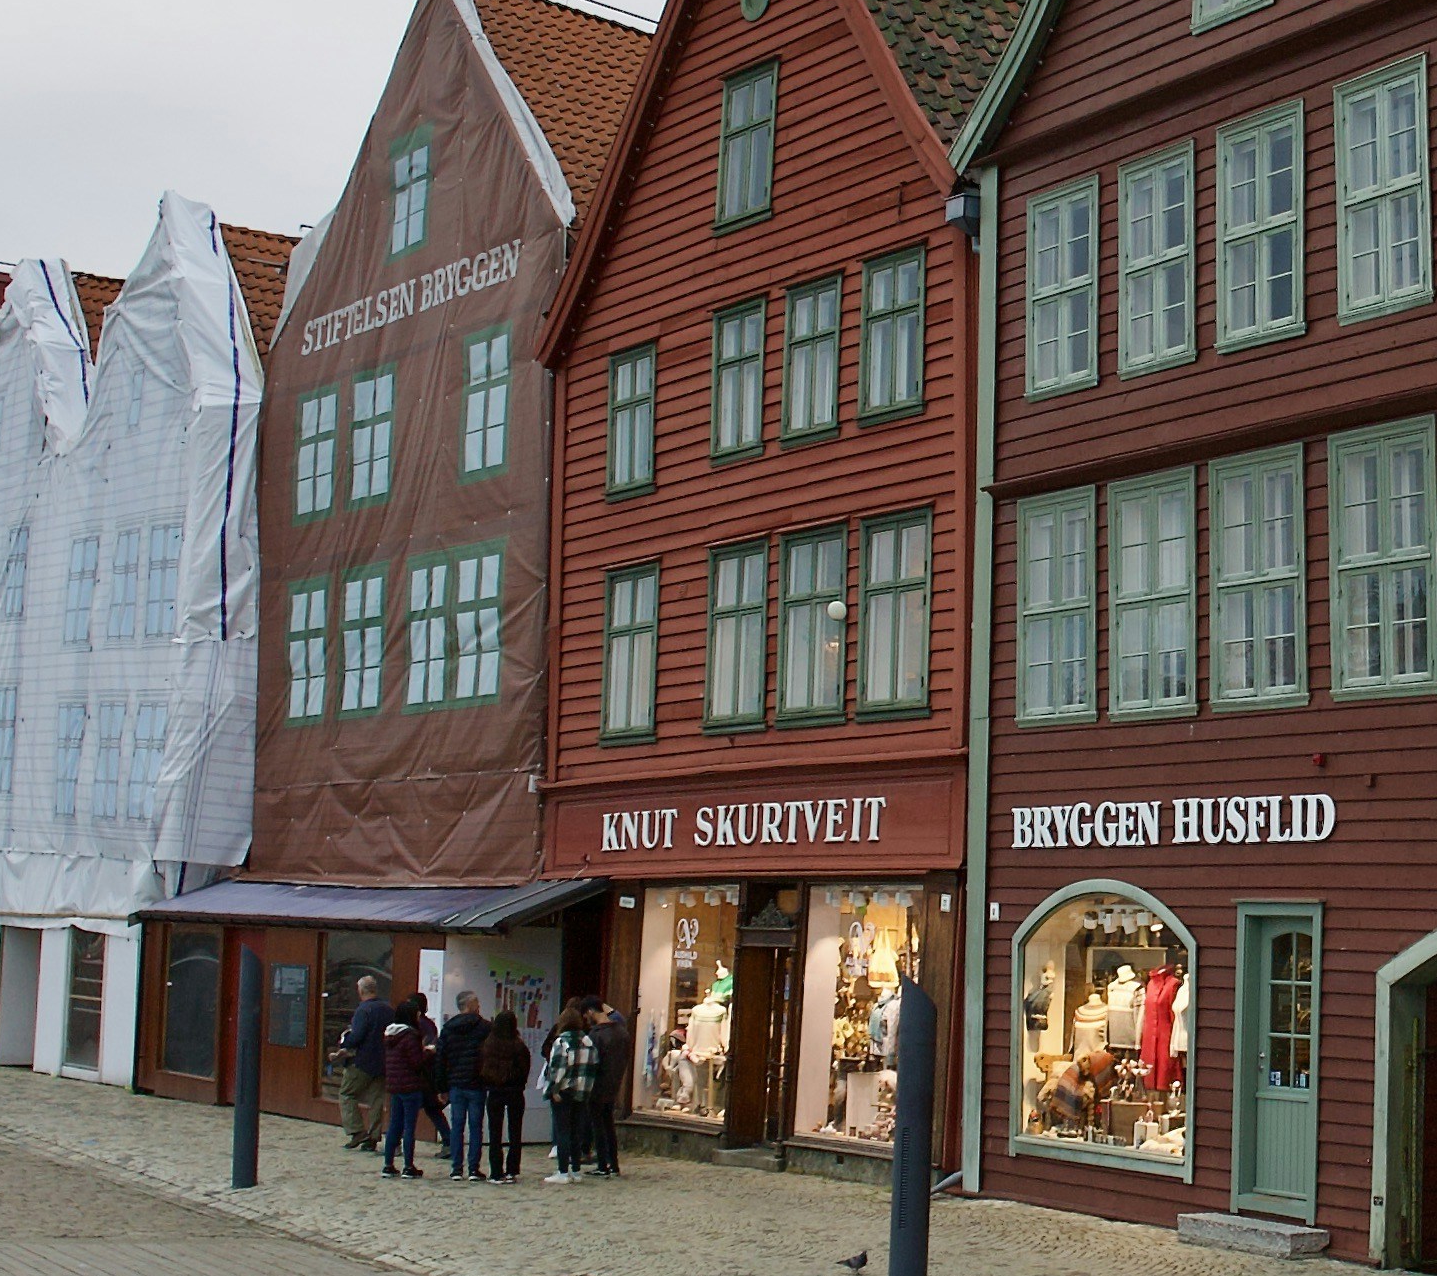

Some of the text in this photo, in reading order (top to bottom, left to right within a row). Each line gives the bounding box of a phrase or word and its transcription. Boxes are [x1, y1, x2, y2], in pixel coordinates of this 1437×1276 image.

[300, 238, 524, 357] STIFTELSEN BRYGGEN
[601, 796, 888, 853] KNUT SKURTVEIT
[1011, 793, 1337, 850] BRYGGEN HUSFLID
